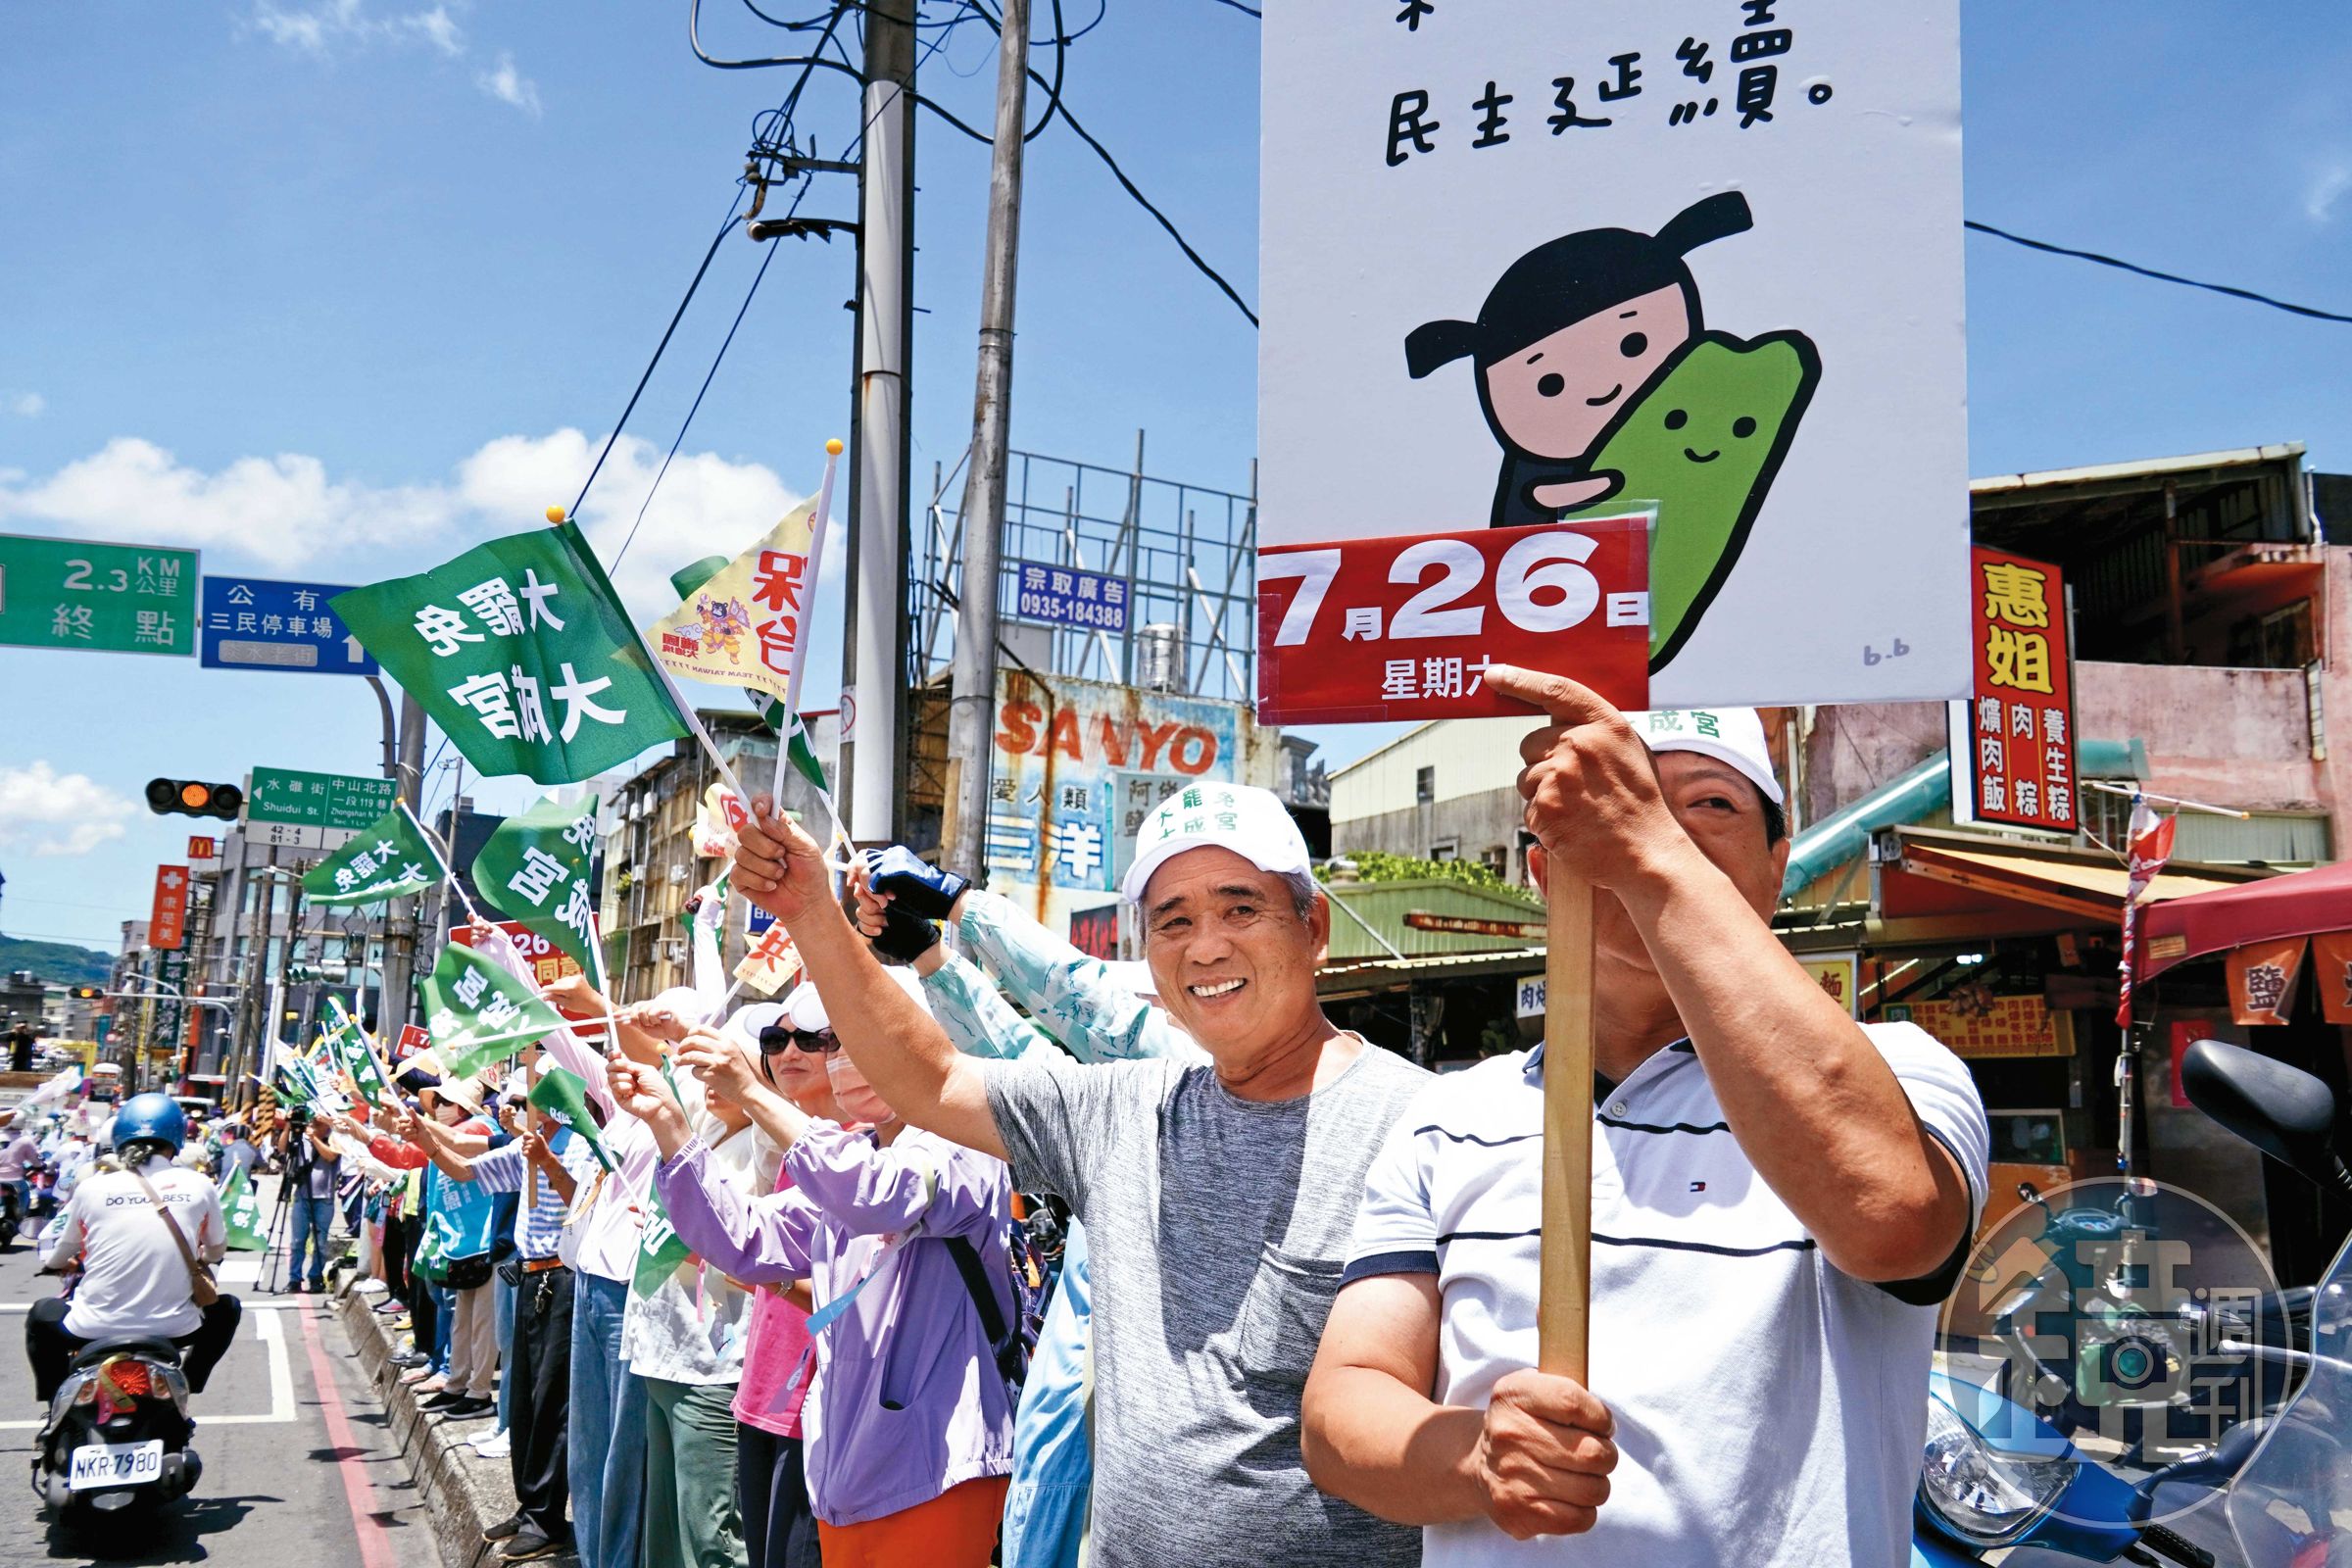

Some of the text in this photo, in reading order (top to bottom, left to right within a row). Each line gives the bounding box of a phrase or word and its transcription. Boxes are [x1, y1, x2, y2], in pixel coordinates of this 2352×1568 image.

[64, 557, 180, 593] 2.3 KM
[135, 577, 178, 597] 公里
[1258, 531, 1649, 647] 7月26日
[227, 584, 320, 612] 公有
[1020, 592, 1123, 629] 0935-184388
[52, 603, 174, 647] 終點
[208, 612, 333, 639] 三民停車場
[1982, 563, 2054, 695] 惠姐
[995, 700, 1218, 776] SANYO
[1631, 710, 1721, 739] 成宮
[2011, 702, 2038, 818] 肉粽
[2043, 708, 2071, 822] 養生粽
[332, 778, 392, 796] 中山北路
[263, 802, 319, 815] Shuidui St.
[985, 813, 1103, 879] 三洋
[159, 897, 177, 942] 康是美
[510, 933, 550, 956] 26
[106, 1197, 123, 1206] DO
[163, 1194, 191, 1202] BEST
[74, 1451, 157, 1479] NKR-7980
